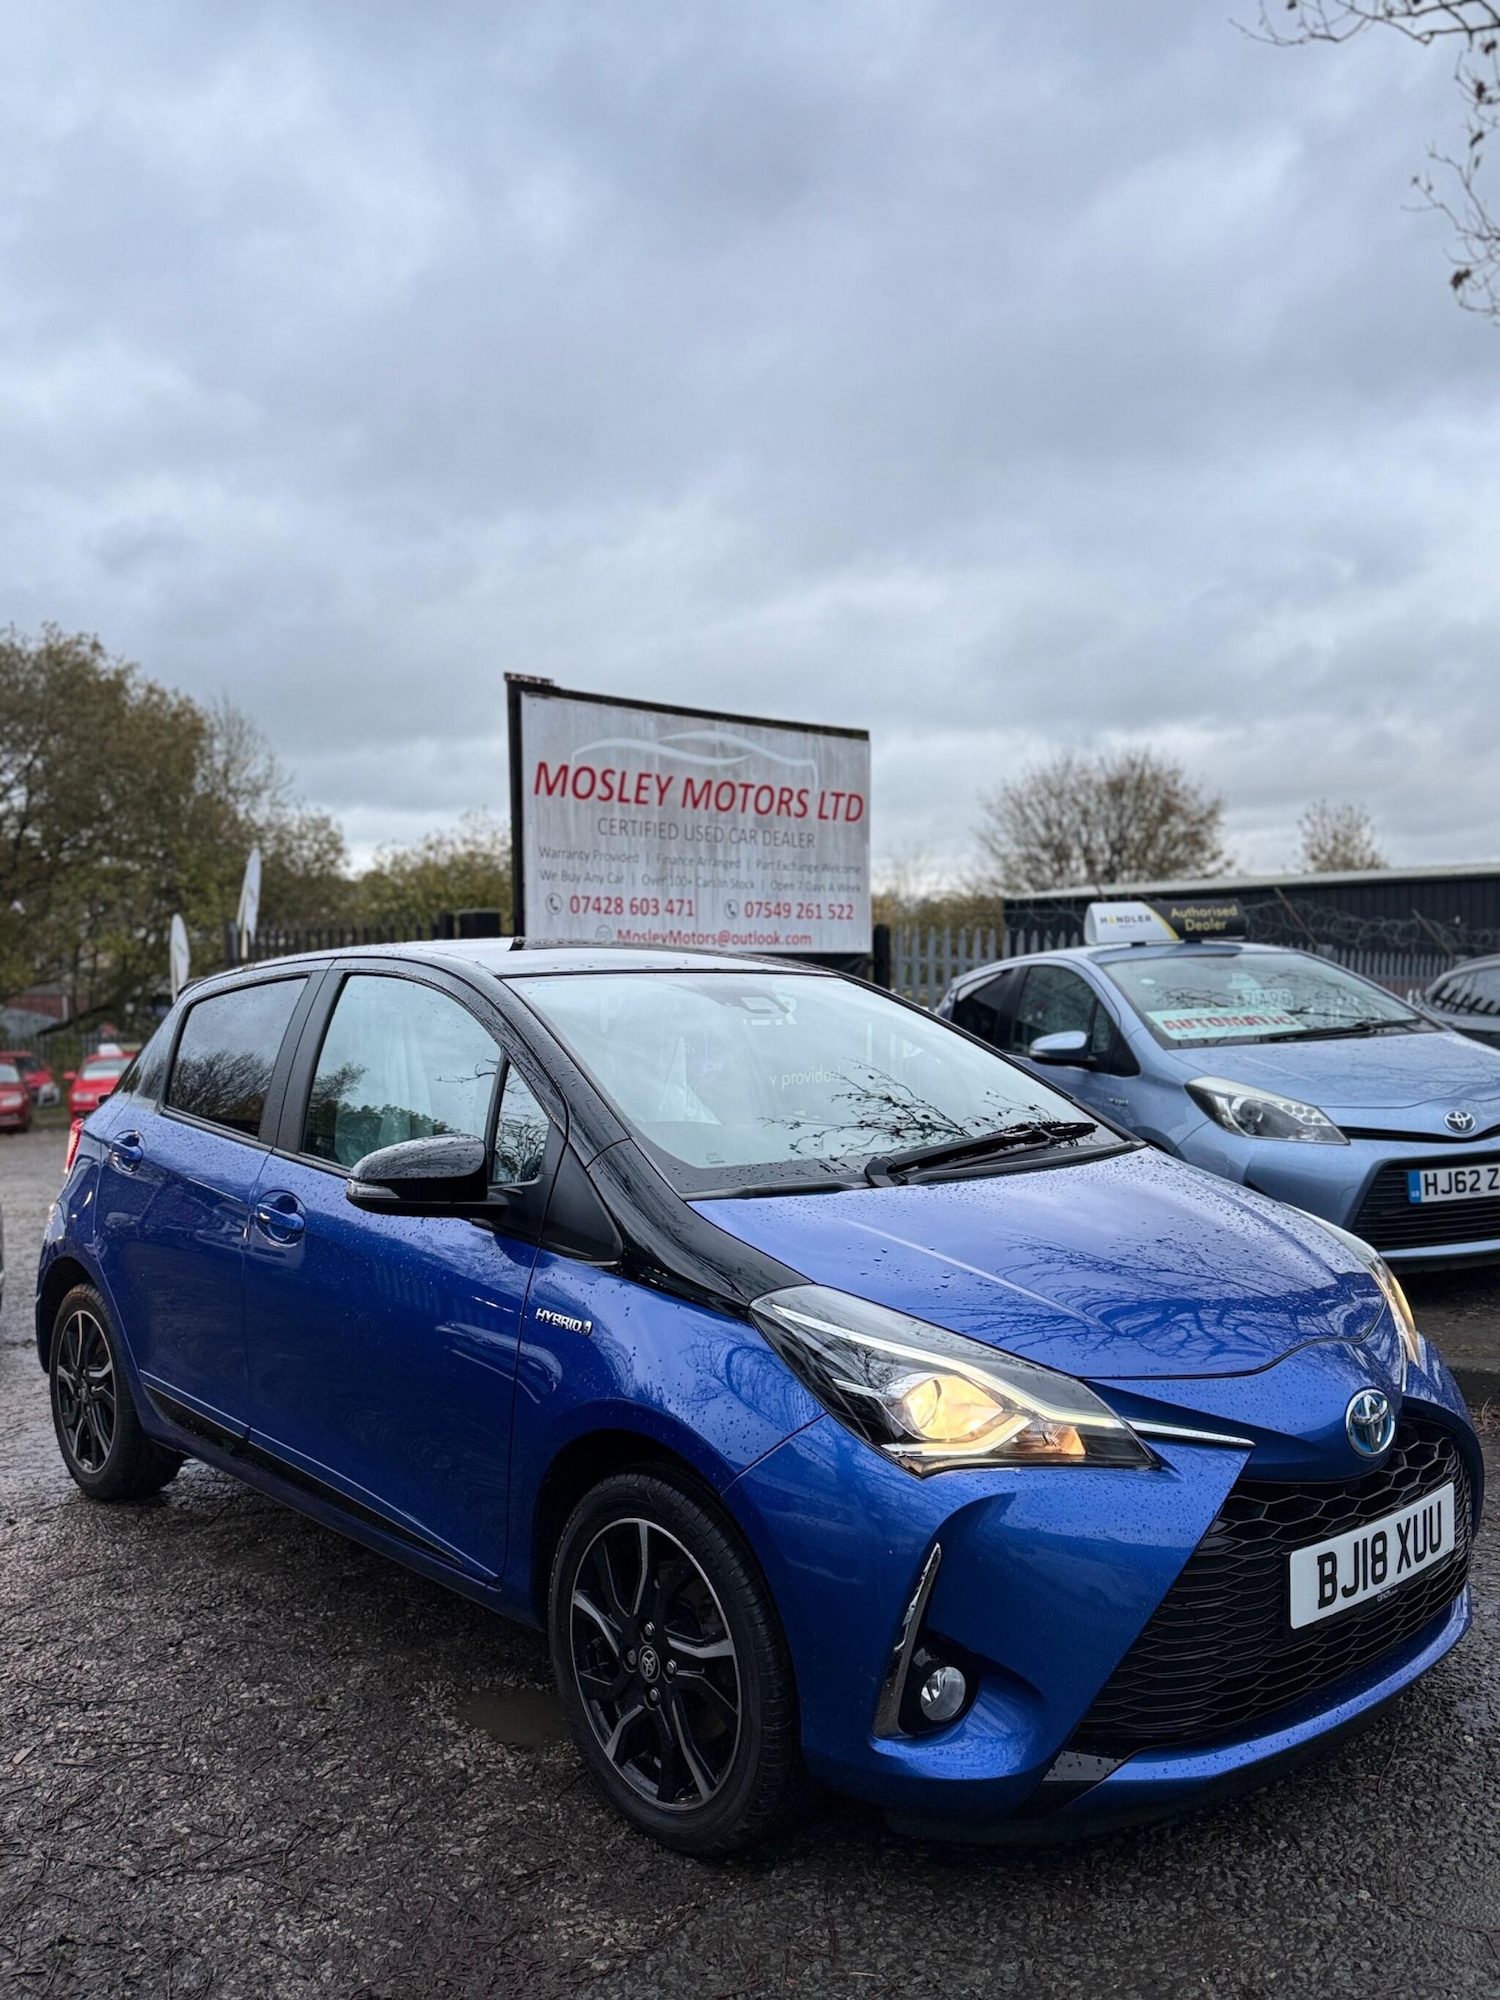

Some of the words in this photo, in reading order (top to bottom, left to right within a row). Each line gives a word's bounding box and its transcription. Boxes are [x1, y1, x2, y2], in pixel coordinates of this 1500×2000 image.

[534, 762, 674, 806] MOSLEY
[681, 777, 810, 819] MOTORS
[817, 790, 864, 822] LTD
[597, 817, 680, 840] CERTIFIED
[684, 824, 724, 843] USED
[728, 827, 757, 845] CAR
[762, 829, 816, 849] DEALER
[538, 846, 590, 863] Warranty
[593, 849, 640, 864] Provided
[656, 853, 695, 866] Finance
[697, 856, 741, 871] Arranged
[756, 859, 775, 870] Part
[777, 860, 819, 874] Exchange
[821, 863, 861, 874] Welcome
[539, 869, 558, 881] We
[561, 870, 581, 883] Buy
[584, 872, 604, 885] Any
[607, 872, 625, 884] Car
[642, 874, 666, 886] Over
[669, 875, 692, 888] 100+
[695, 876, 716, 888] Cars
[730, 879, 755, 890] Stock
[770, 880, 795, 892] Open
[797, 881, 804, 891] 7
[805, 882, 826, 893] Days
[828, 883, 836, 891] A
[836, 883, 861, 893] Week
[569, 895, 624, 915] 07428
[629, 897, 660, 916] 603
[664, 898, 695, 917] 471
[744, 901, 792, 919] 07549
[796, 902, 823, 920] 261
[828, 904, 854, 920] 522
[1171, 904, 1238, 919] Authorised
[1100, 914, 1152, 924] HANDLER
[1184, 918, 1228, 932] Dealer
[1162, 1015, 1297, 1031] AUTOMATIC
[1424, 1169, 1481, 1196] HJ62
[535, 1308, 583, 1332] HYBRID
[1317, 1530, 1388, 1610] BJ18
[1396, 1500, 1442, 1575] XUU
